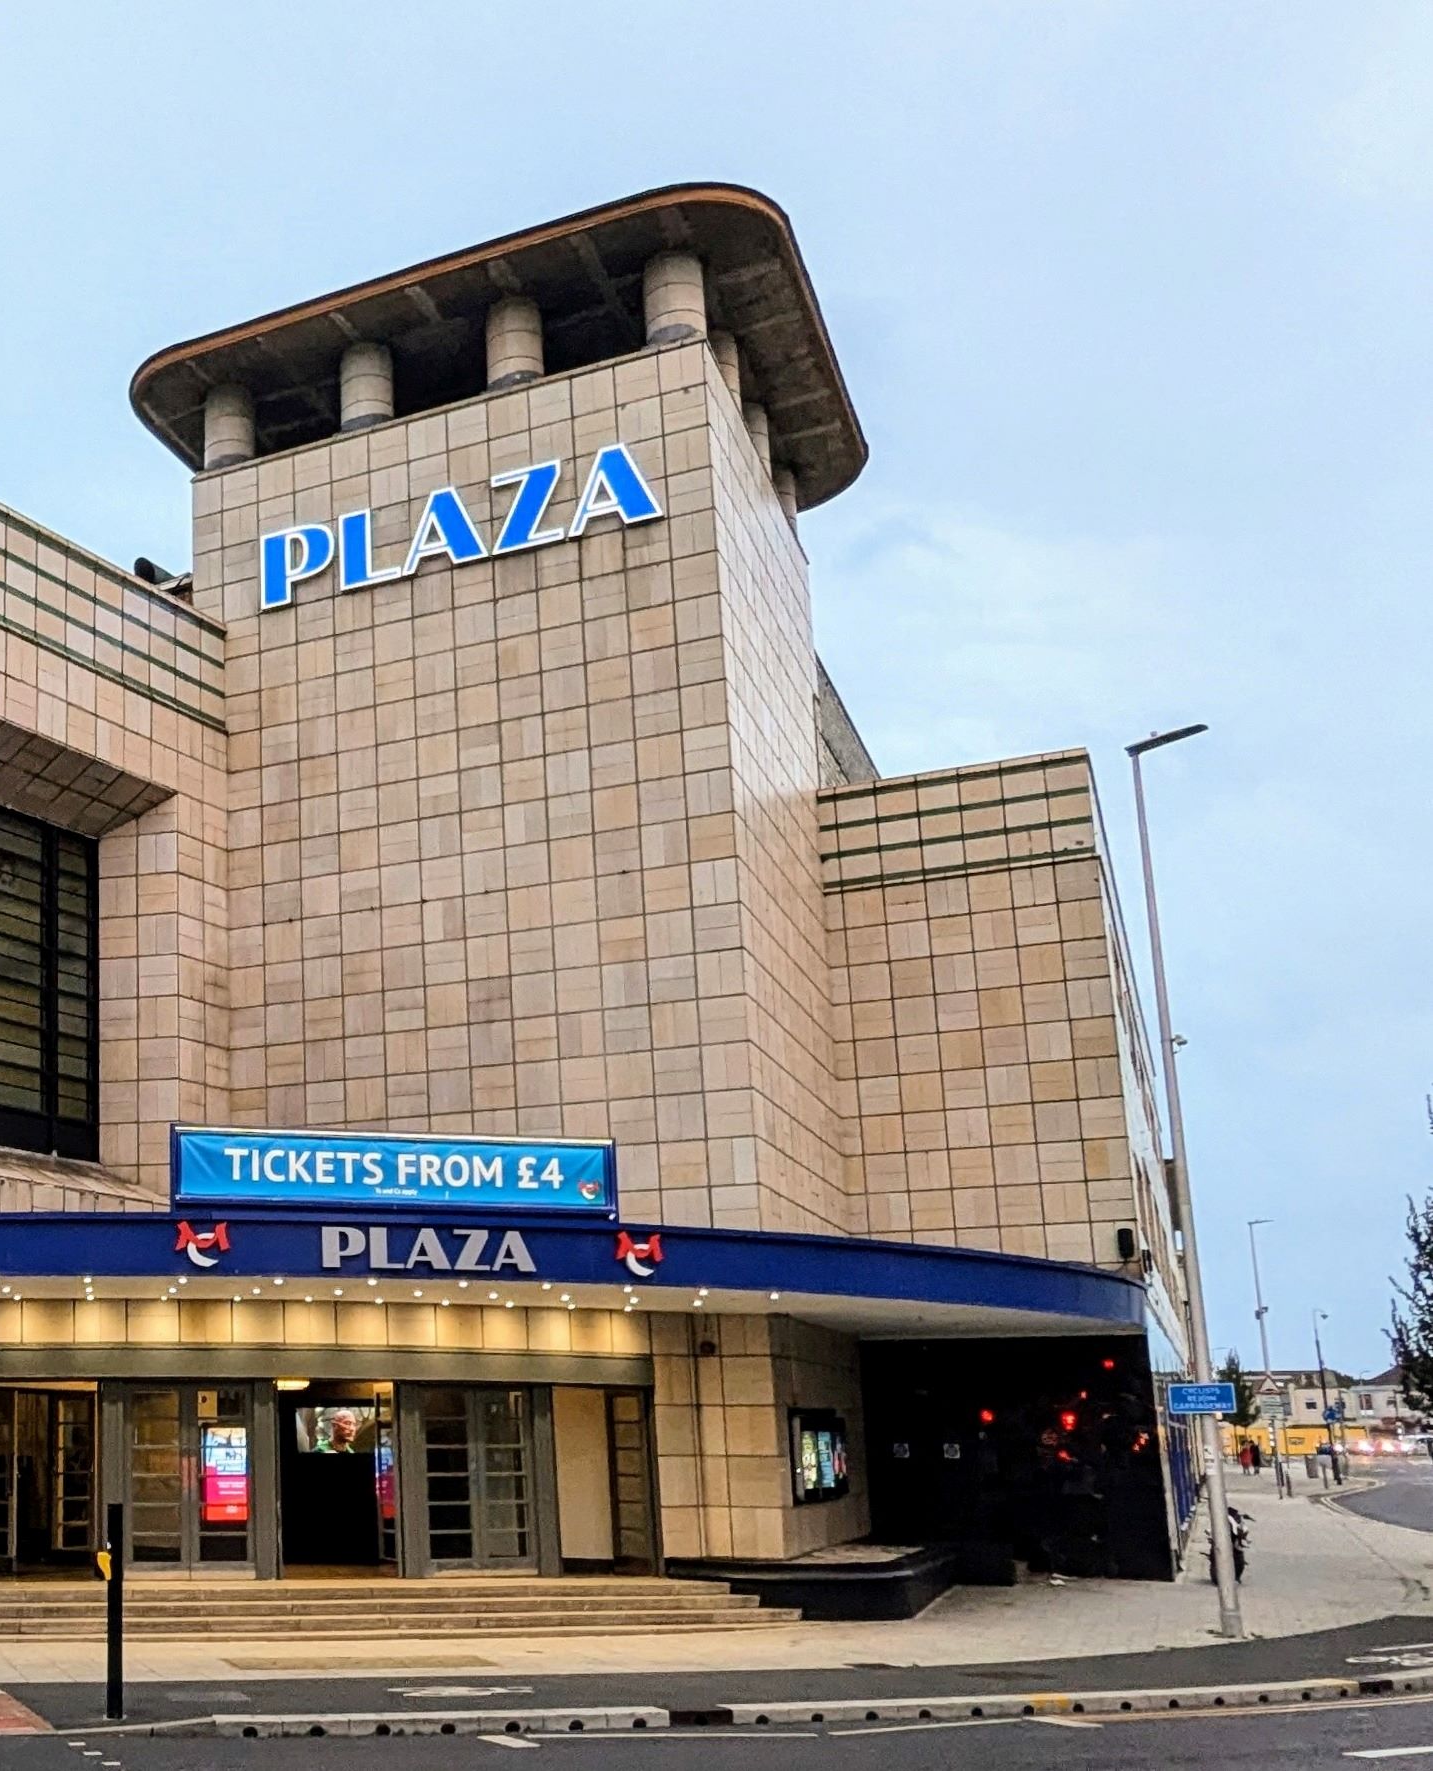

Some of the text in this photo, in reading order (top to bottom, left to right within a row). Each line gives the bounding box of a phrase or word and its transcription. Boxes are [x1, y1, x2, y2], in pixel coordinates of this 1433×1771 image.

[260, 442, 663, 609] PLAZA
[224, 1147, 565, 1190] TICKETS FROM £4
[321, 1226, 537, 1272] PLAZA
[1173, 1402, 1232, 1410] CARRIAGEWAY
[1181, 1387, 1221, 1395] CYCLISTS
